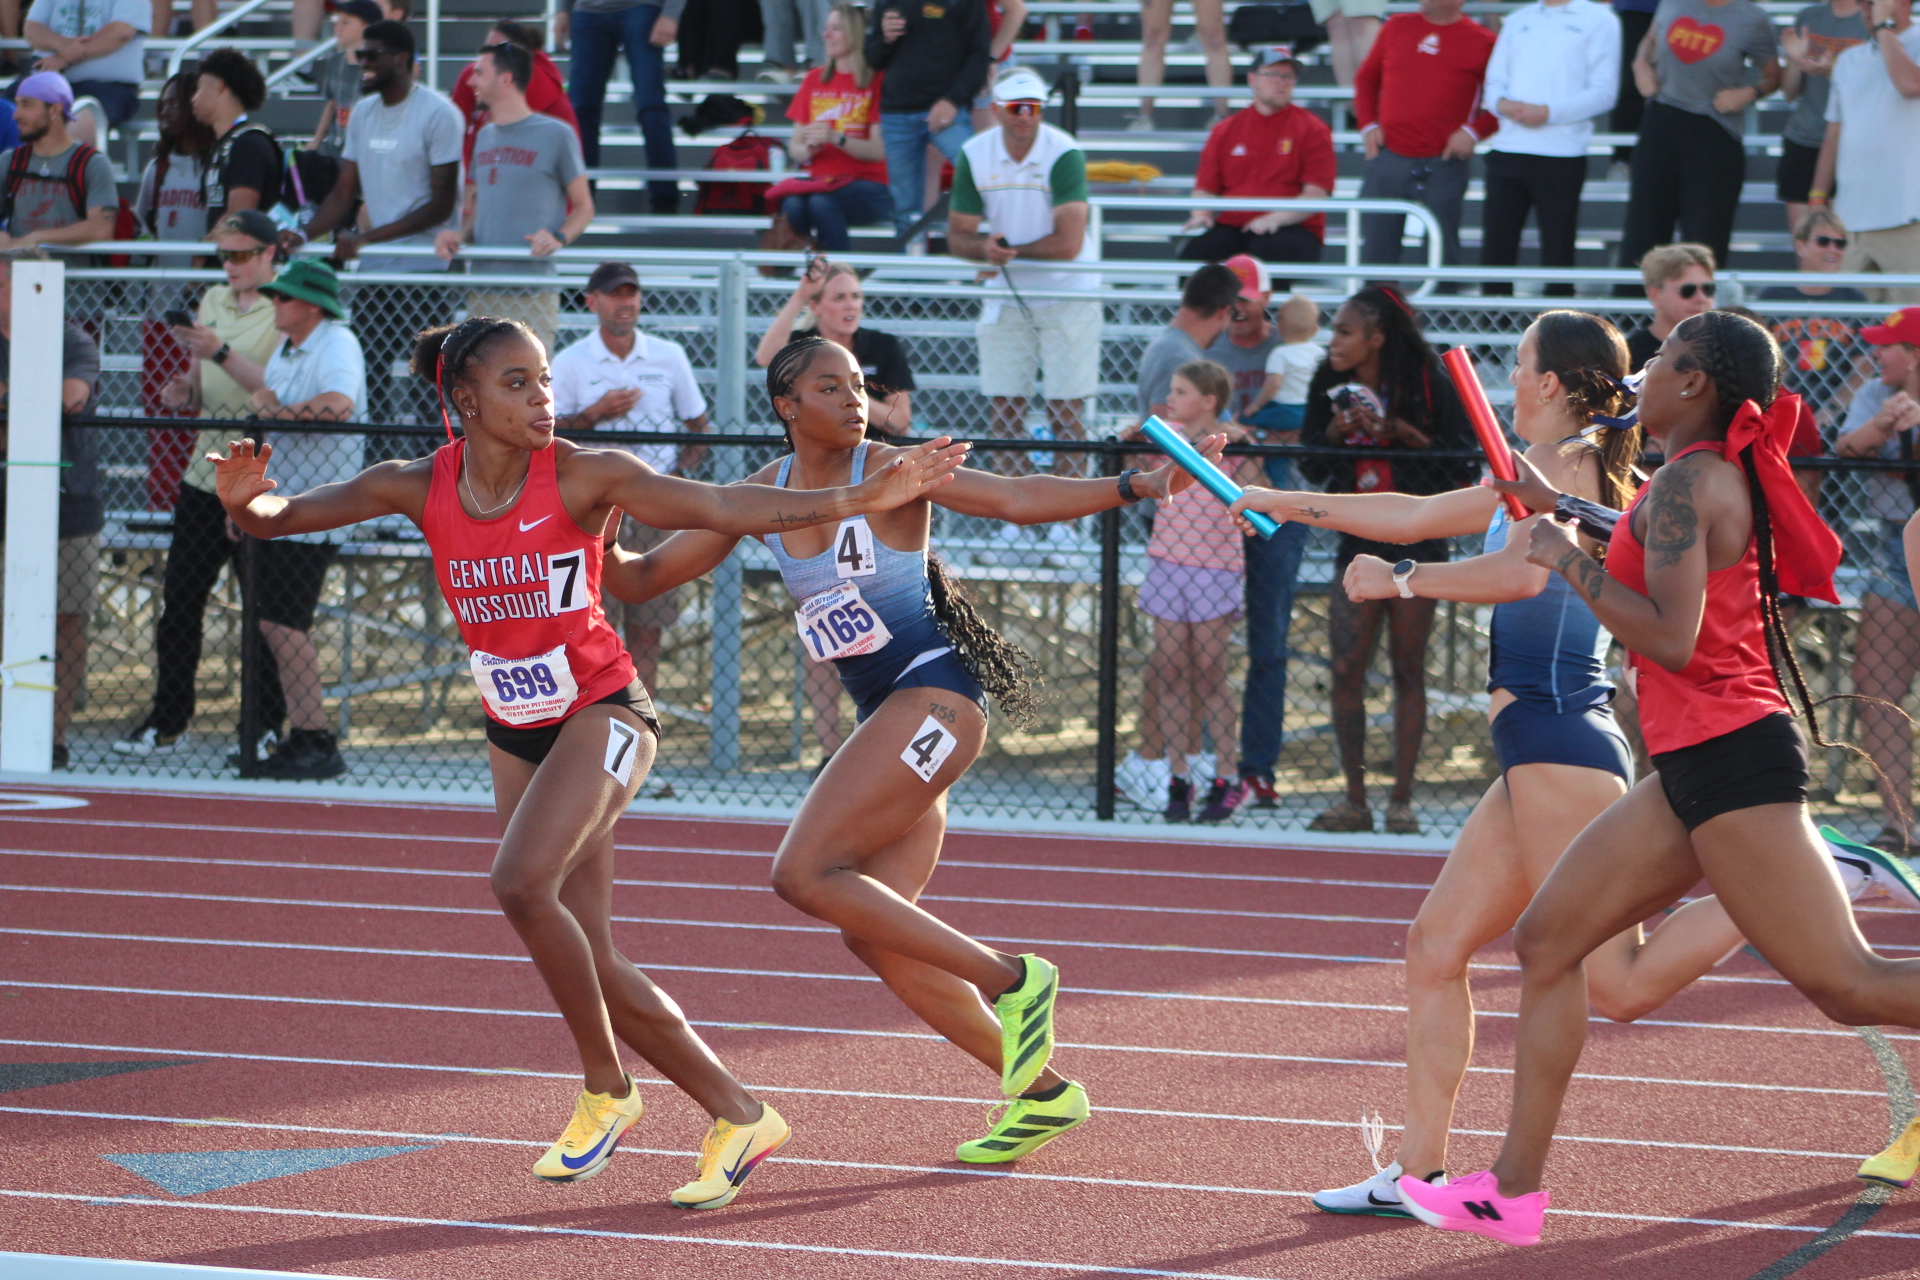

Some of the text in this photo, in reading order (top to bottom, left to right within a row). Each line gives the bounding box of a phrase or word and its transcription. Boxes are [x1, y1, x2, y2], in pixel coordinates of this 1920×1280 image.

[1668, 27, 1721, 55] PITT
[838, 526, 863, 571] 4
[449, 552, 550, 588] CENTRAL
[553, 555, 580, 609] 7
[454, 590, 559, 624] MISSOUR
[806, 599, 875, 658] 1165
[490, 663, 558, 703] 699
[531, 698, 567, 707] PITTSBURG
[929, 702, 957, 723] 758
[611, 723, 634, 774] 7
[910, 728, 944, 769] 4
